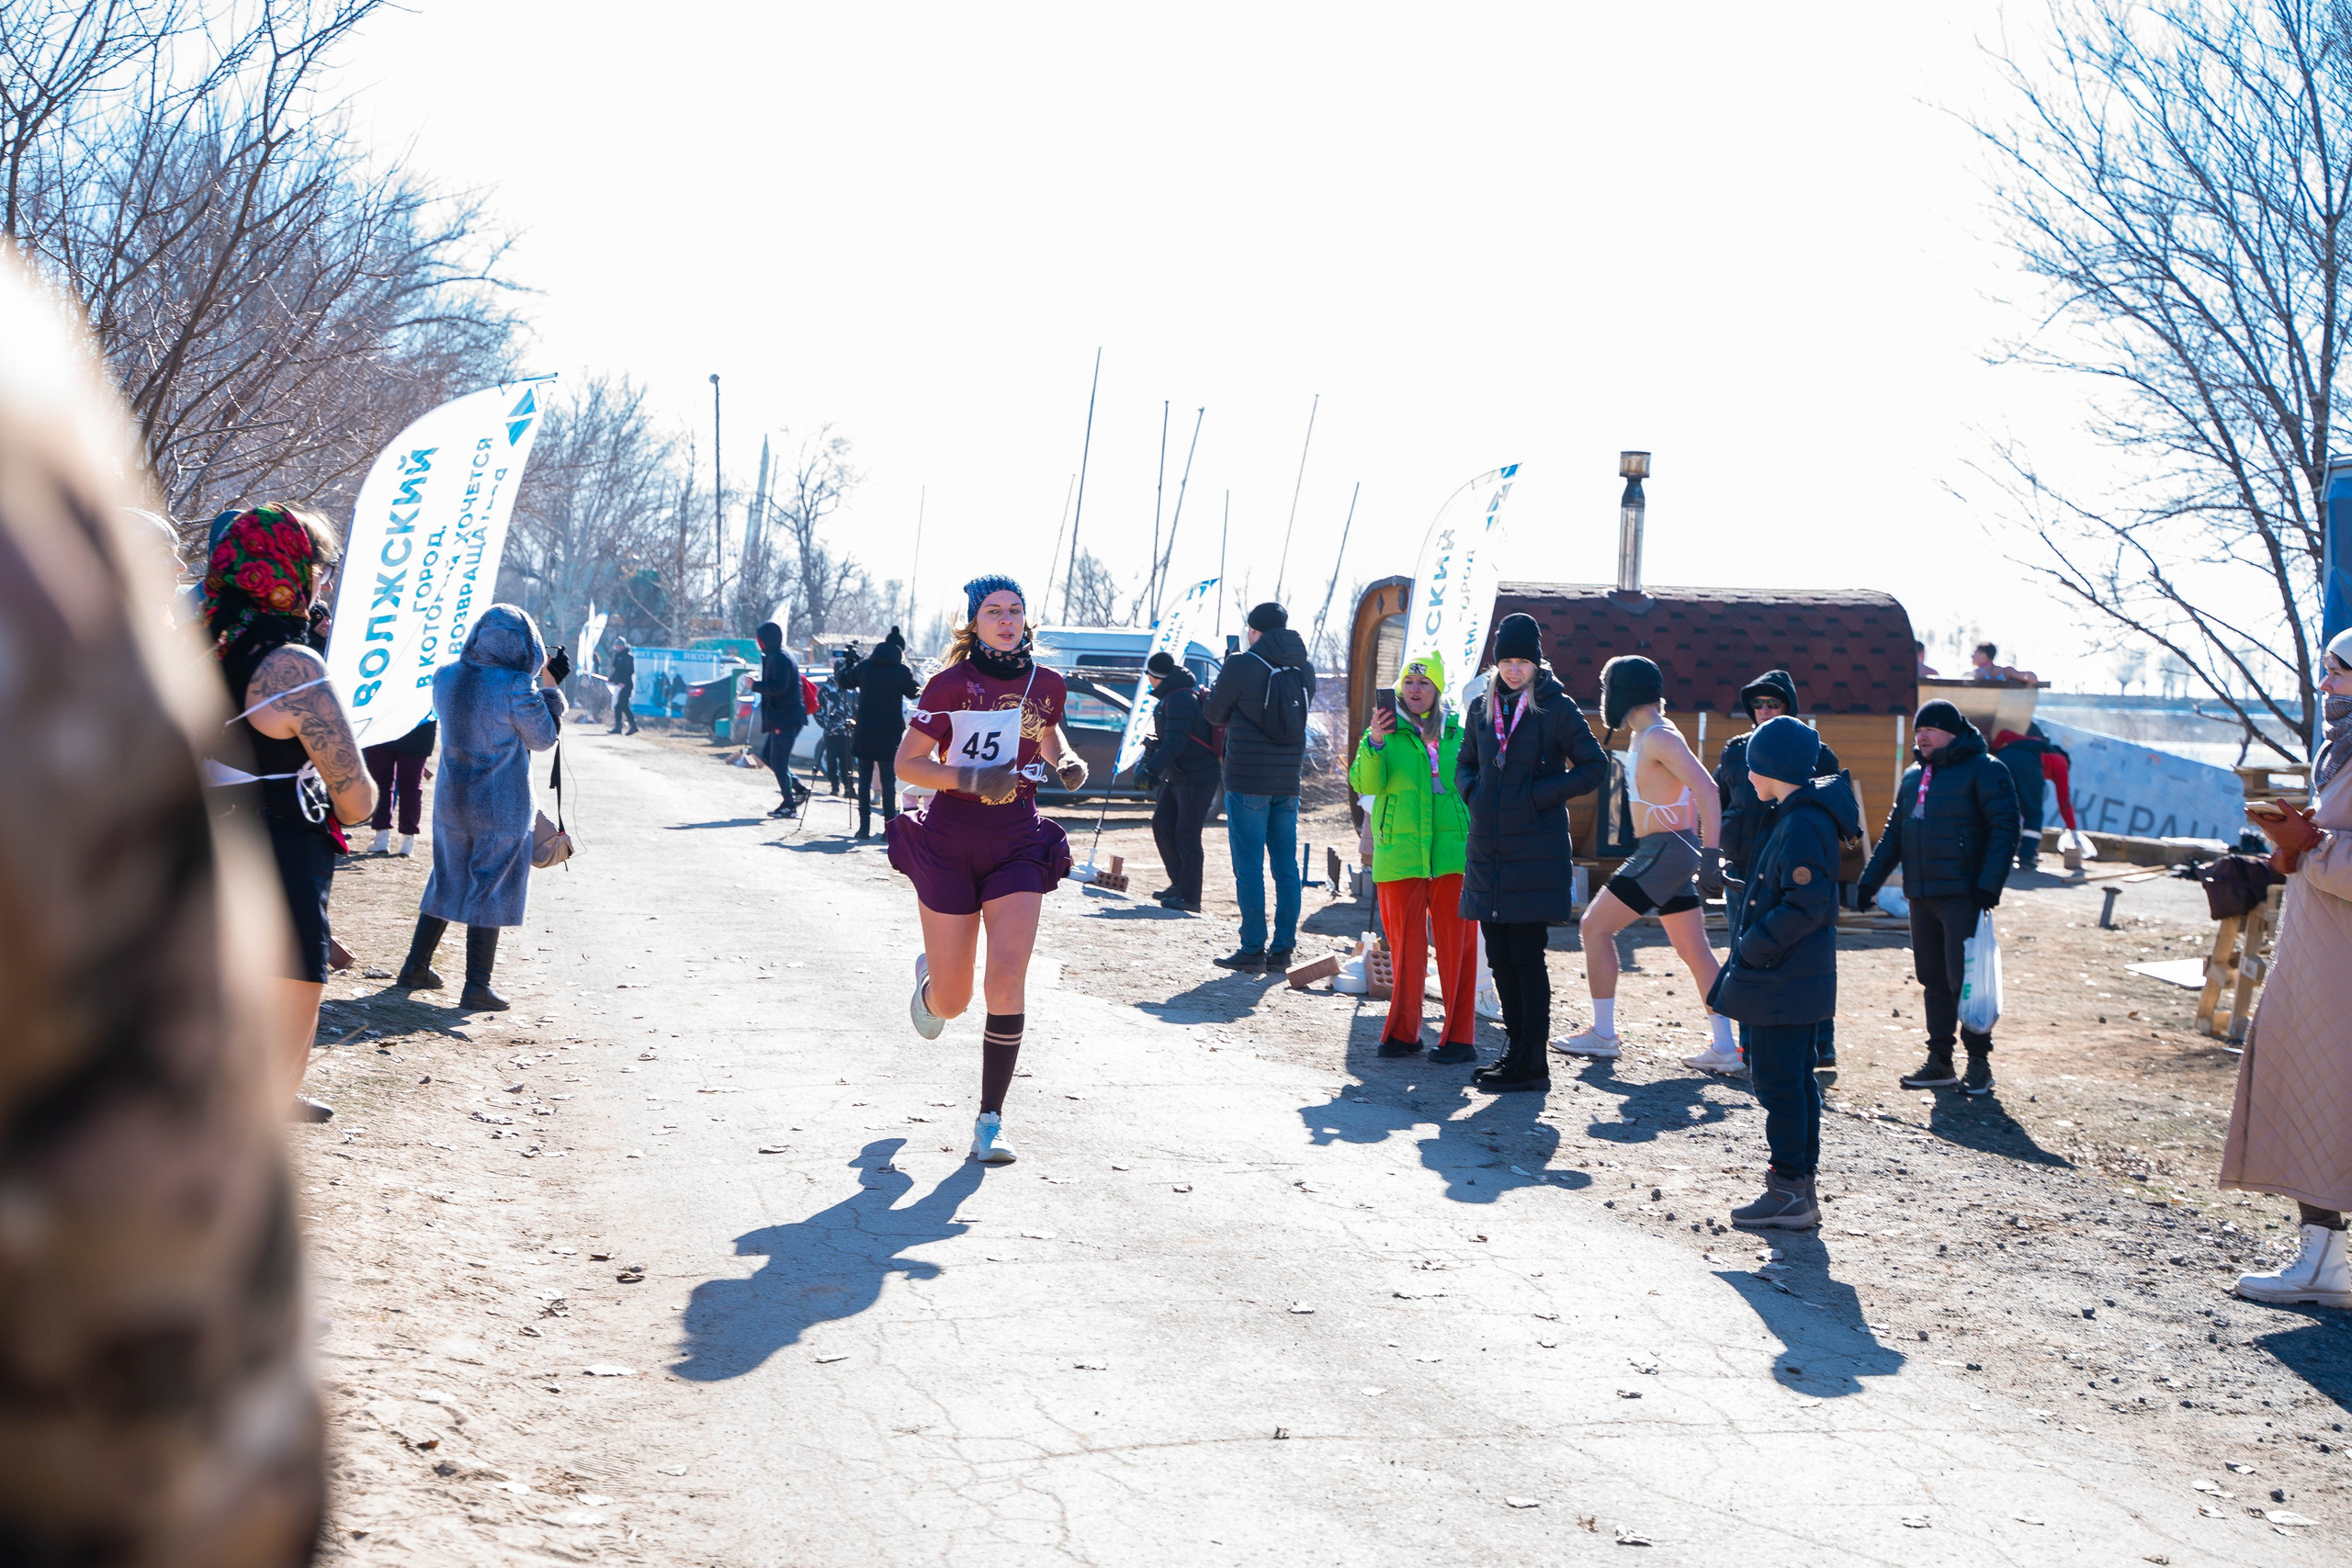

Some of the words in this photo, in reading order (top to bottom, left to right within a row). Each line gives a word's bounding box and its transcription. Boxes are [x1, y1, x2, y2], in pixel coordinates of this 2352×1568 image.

[454, 437, 493, 546] ХОЧЕТСЯ
[353, 447, 439, 707] ВОЛЖСКИЙ
[419, 555, 459, 668] КОТОЙ
[415, 674, 433, 688] В
[683, 652, 716, 662] ЯКОР
[962, 731, 1001, 761] 45
